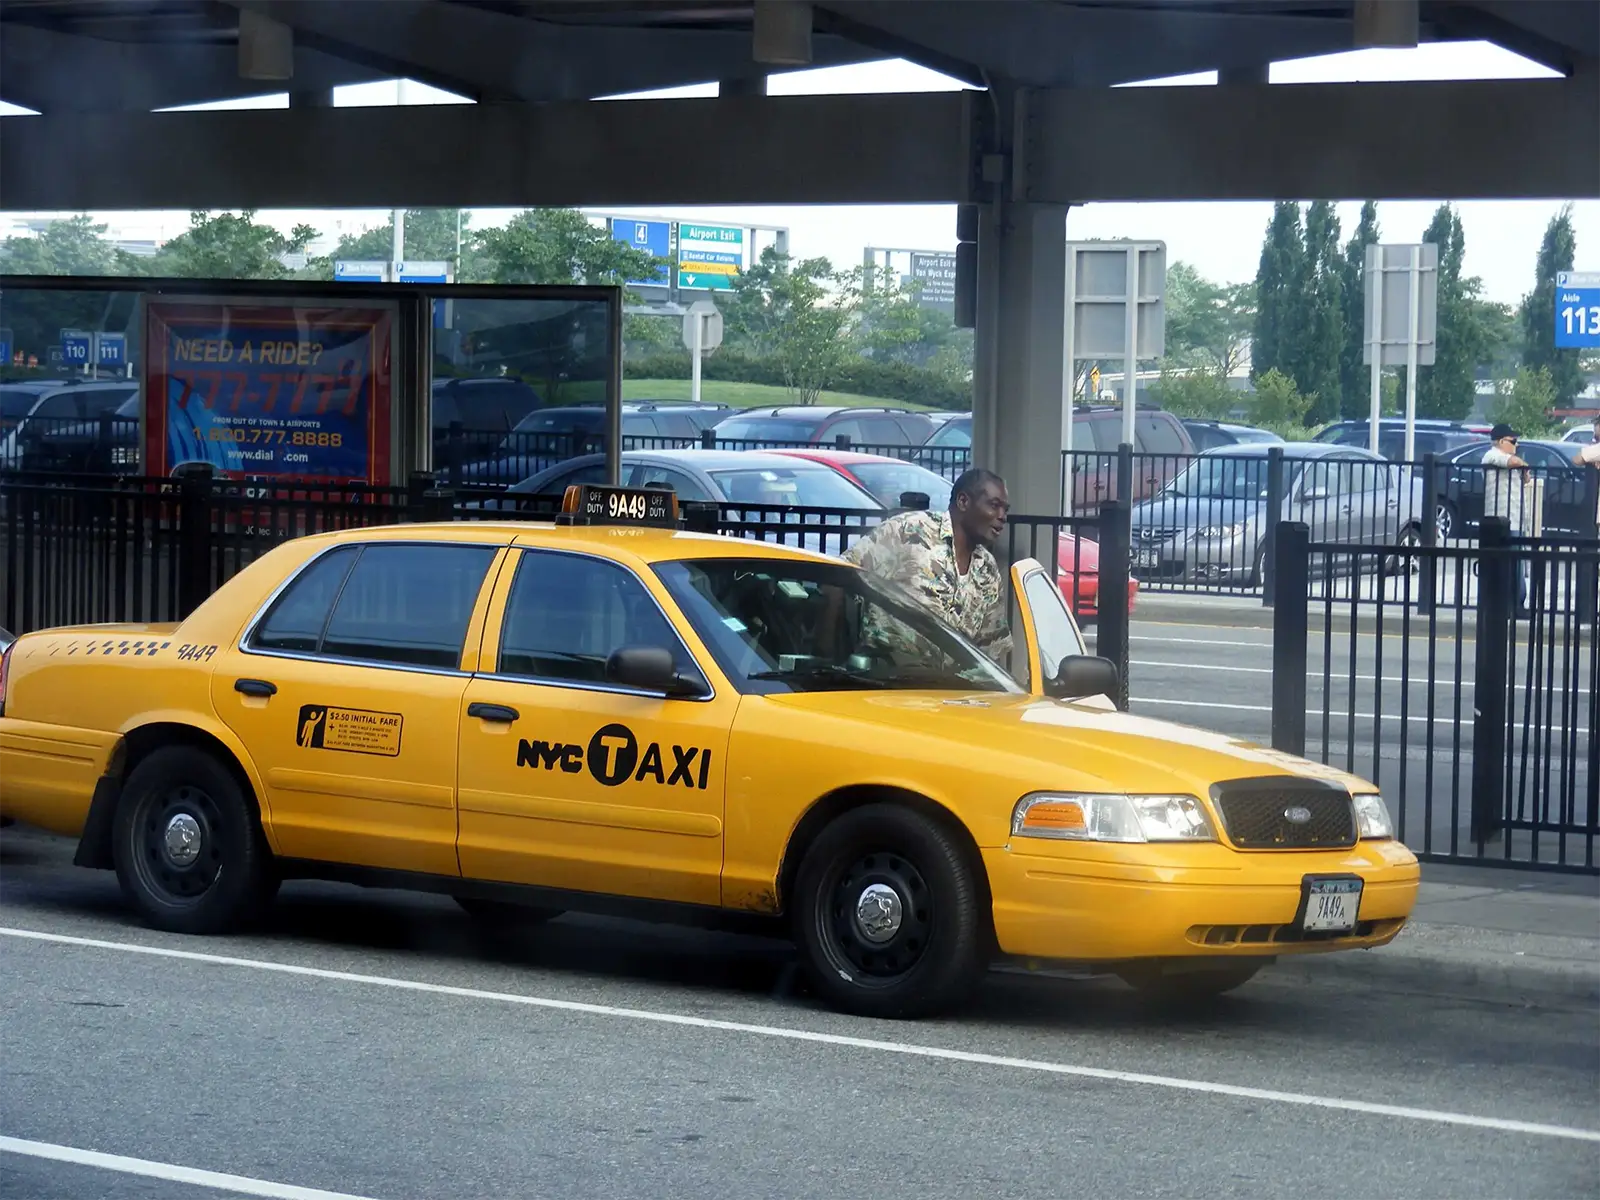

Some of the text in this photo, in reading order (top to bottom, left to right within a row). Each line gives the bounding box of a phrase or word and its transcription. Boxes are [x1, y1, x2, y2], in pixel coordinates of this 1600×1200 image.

[637, 225, 645, 239] 4
[689, 227, 735, 241] Airport Exit
[706, 253, 715, 261] Car
[919, 257, 939, 267] Airport
[940, 258, 951, 268] Exit
[944, 269, 956, 279] Exp
[1561, 293, 1580, 303] Aisle
[1561, 306, 1600, 335] 113
[66, 346, 86, 359] 110
[100, 346, 118, 359] 111
[174, 338, 323, 366] NEED A RIDE?
[212, 416, 231, 424] FROM
[232, 418, 246, 426] OUT
[248, 418, 258, 426] OF
[259, 419, 278, 427] TOWN
[287, 420, 321, 429] AIRPORTS
[193, 426, 342, 448] 1.800.777.8888
[587, 503, 666, 517] DUTY DUTY
[590, 491, 664, 519] OFF 9A49 OFF
[177, 644, 218, 663] 9A49
[330, 712, 398, 727] $2.50 INITIAL FARE
[516, 734, 711, 790] NYC TAXI
